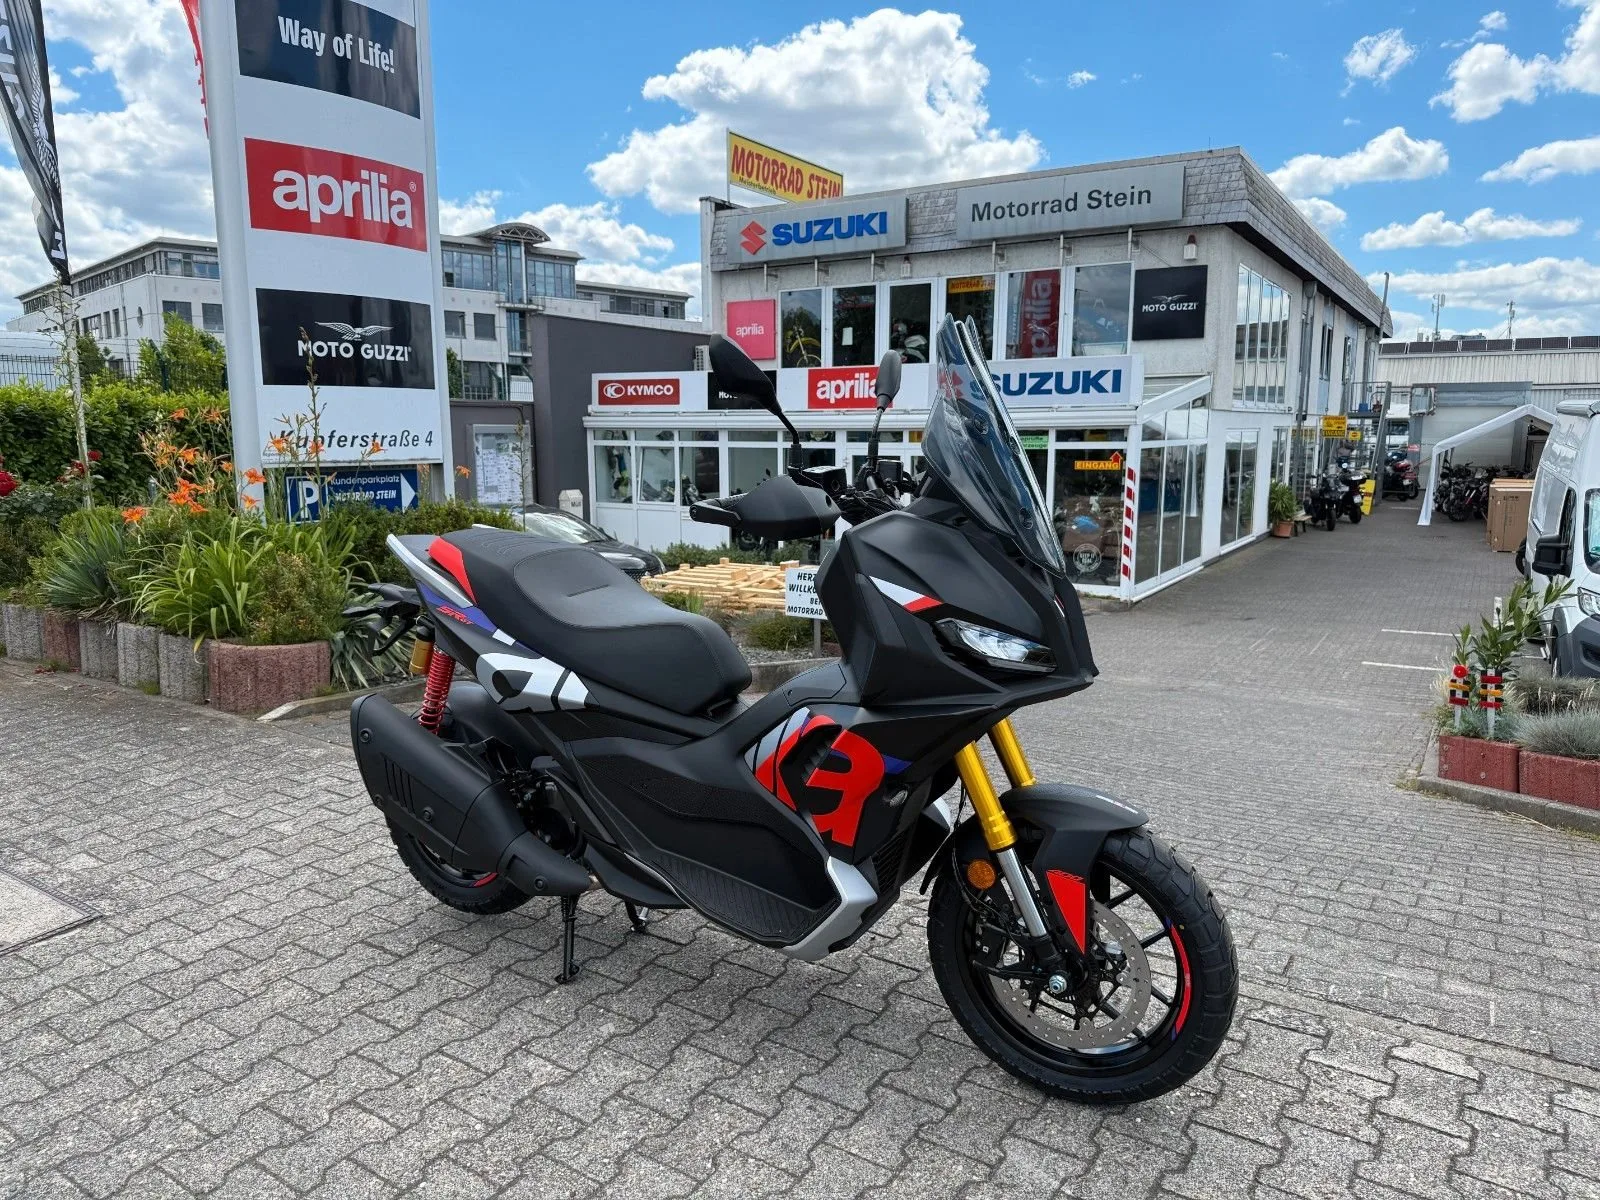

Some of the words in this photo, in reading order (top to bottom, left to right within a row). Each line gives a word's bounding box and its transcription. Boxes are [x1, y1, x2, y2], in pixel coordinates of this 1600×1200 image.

[278, 15, 325, 57] Way
[332, 33, 353, 60] of
[358, 39, 396, 74] Life!
[731, 143, 804, 195] MOTORRAD
[807, 173, 841, 199] STEIN
[971, 192, 1078, 222] Motorrad
[1087, 186, 1152, 210] Stein
[772, 211, 888, 247] SUZUKI
[1142, 303, 1166, 313] MOTO
[1169, 302, 1197, 311] GUZZI
[1025, 278, 1056, 358] prilia
[735, 323, 764, 337] aprilia
[298, 340, 354, 358] MOTO
[360, 343, 409, 362] GUZZI
[627, 385, 674, 396] KYMCO
[425, 430, 433, 447] 4
[1076, 461, 1119, 469] EINGANG
[331, 475, 400, 486] Kundenparkplatz
[299, 481, 319, 519] P
[376, 489, 397, 499] STEIN
[787, 605, 824, 616] MOTORRAD
